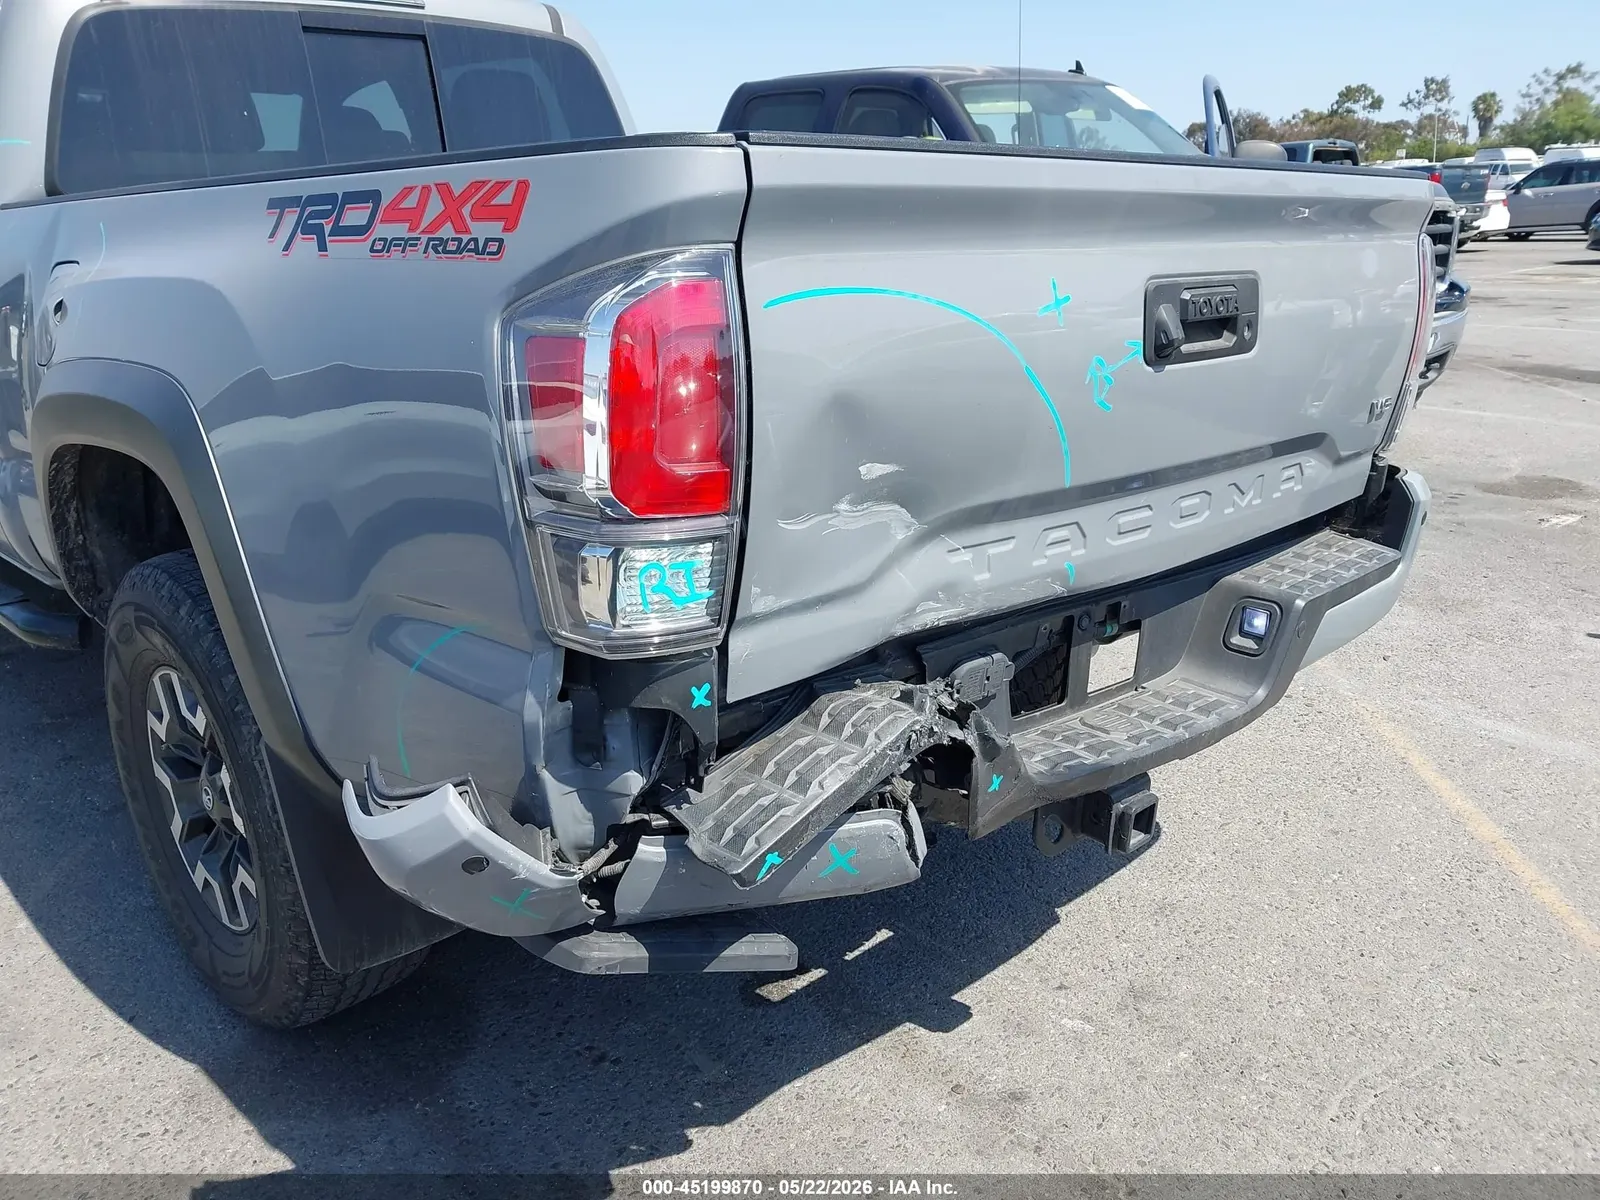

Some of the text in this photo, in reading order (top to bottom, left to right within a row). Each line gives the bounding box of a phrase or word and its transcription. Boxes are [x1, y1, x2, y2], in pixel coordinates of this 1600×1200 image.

[265, 178, 532, 257] TRD 4X4
[369, 236, 507, 261] OFF ROAD
[1190, 293, 1239, 318] TOYOTA
[944, 458, 1317, 581] TACOMA
